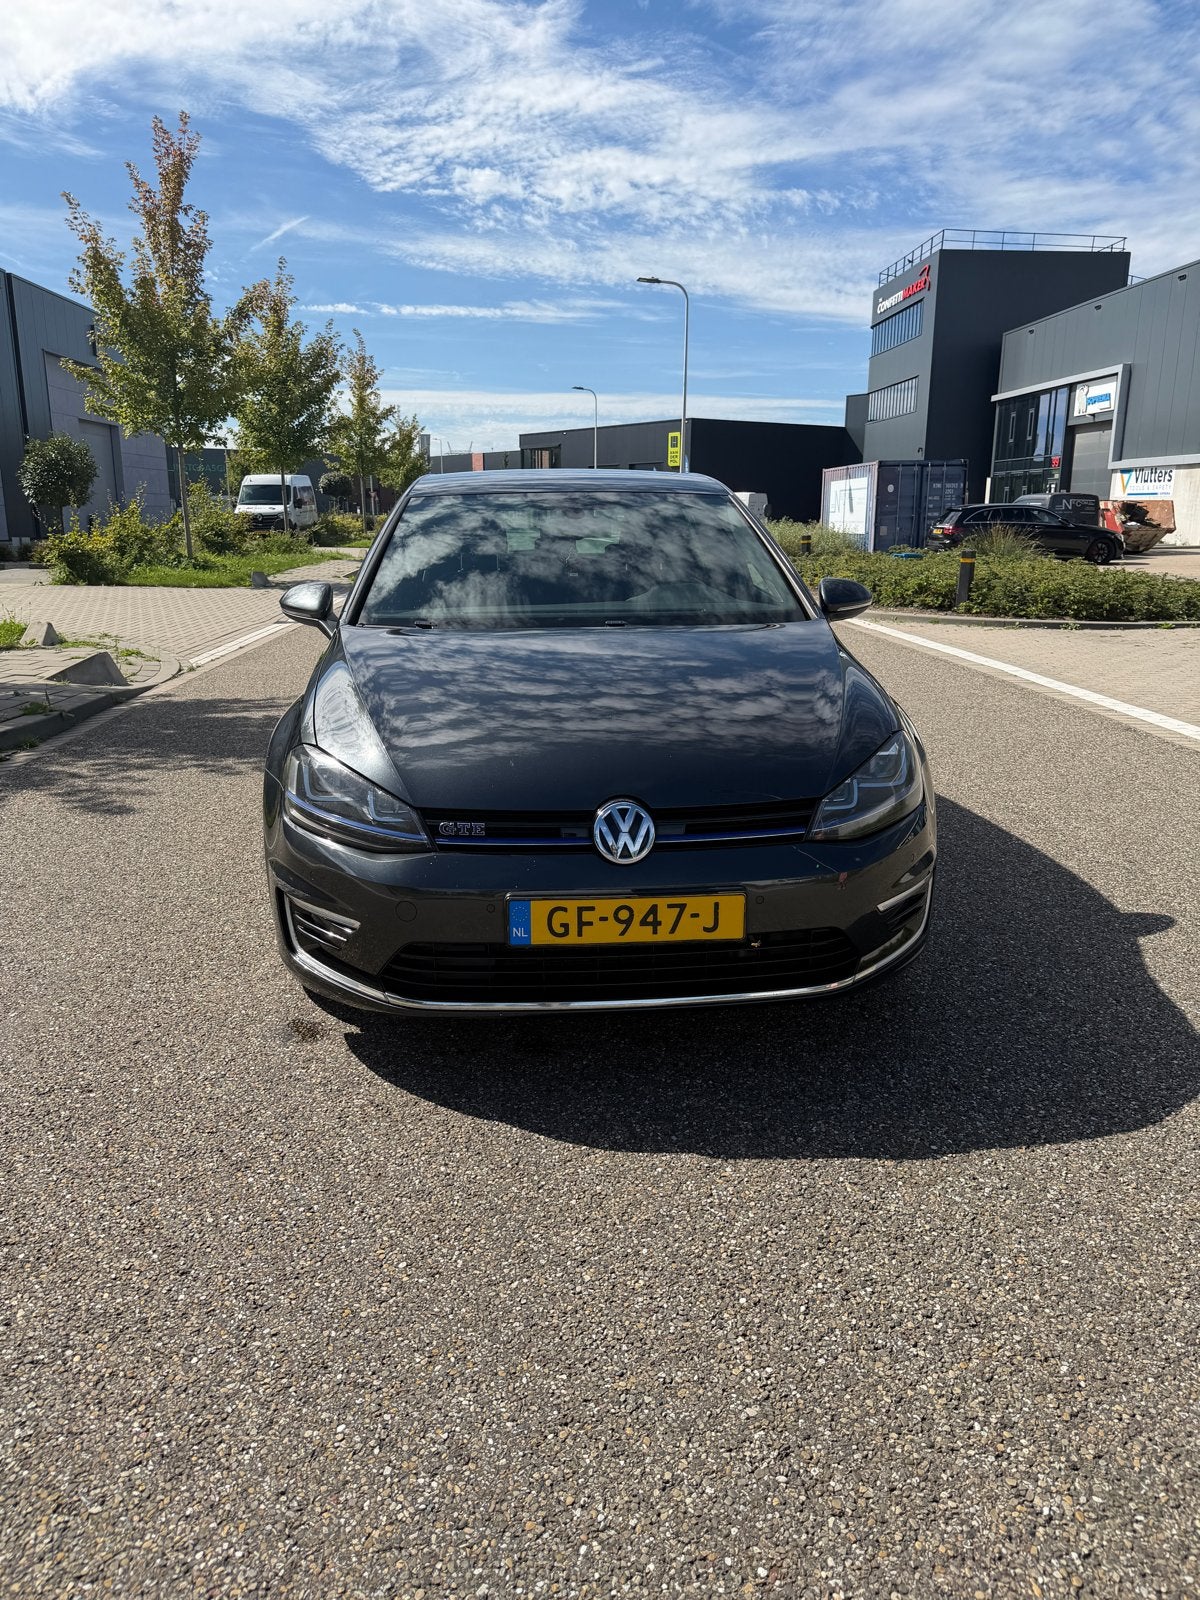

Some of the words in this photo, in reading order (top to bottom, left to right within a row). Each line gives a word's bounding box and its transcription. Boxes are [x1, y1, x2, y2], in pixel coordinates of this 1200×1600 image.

[1134, 467, 1173, 484] Vlutters
[439, 821, 486, 836] GTE
[512, 927, 528, 937] NL
[547, 902, 720, 938] GF-947-J
